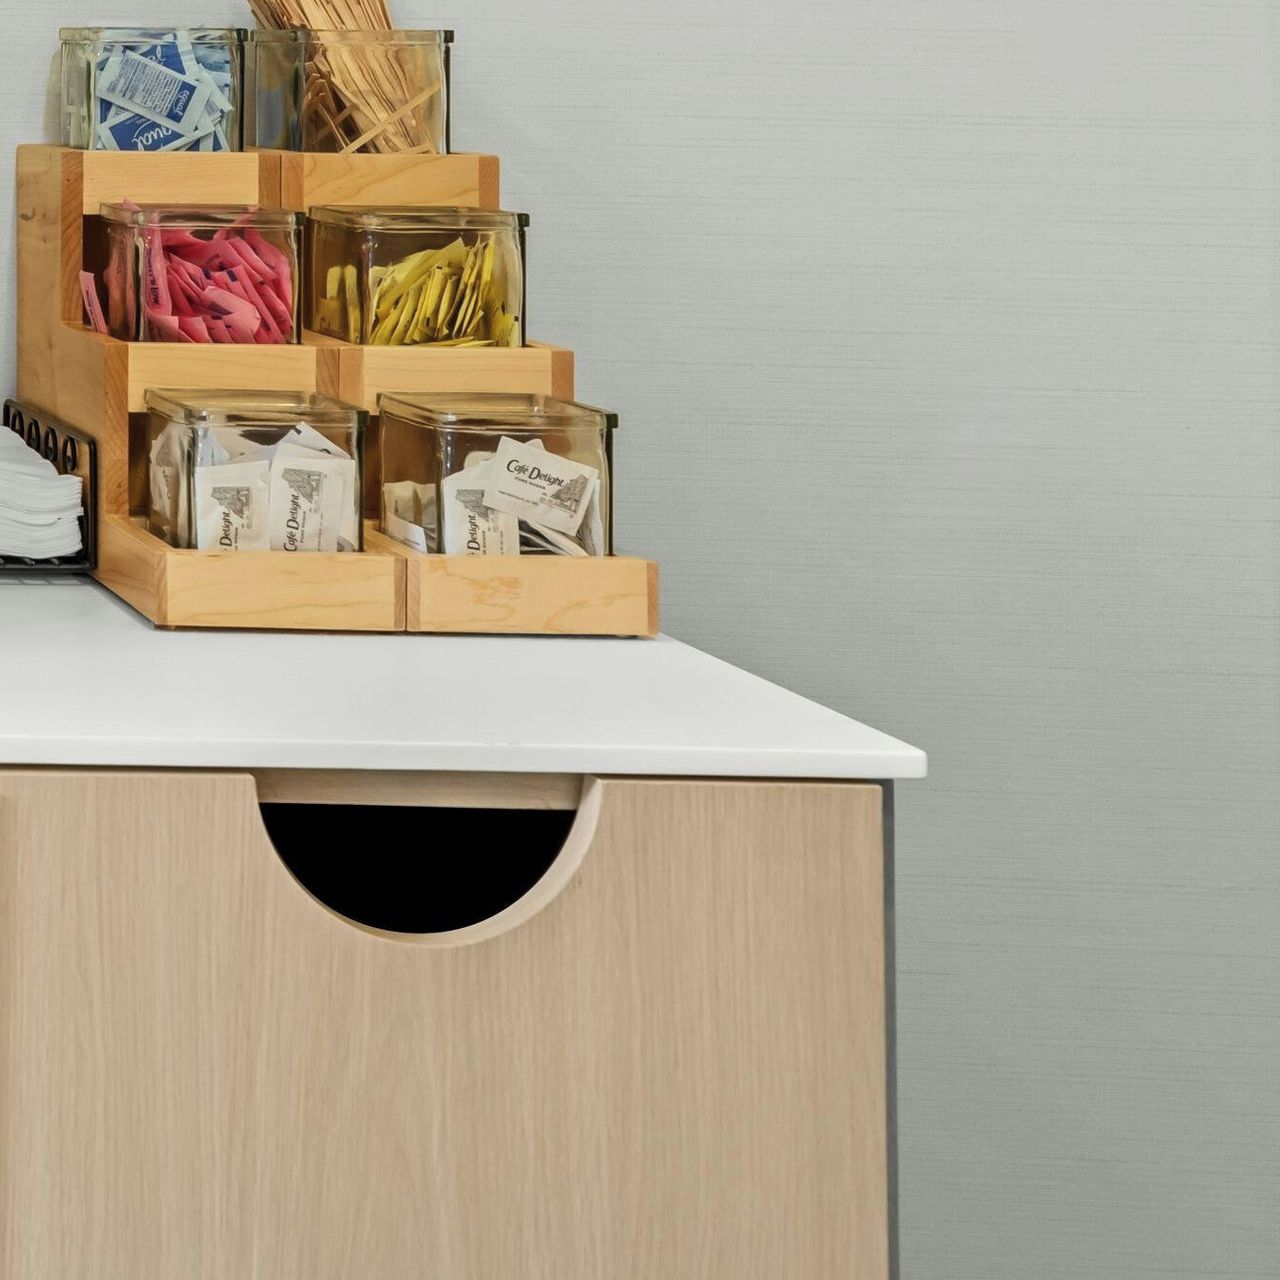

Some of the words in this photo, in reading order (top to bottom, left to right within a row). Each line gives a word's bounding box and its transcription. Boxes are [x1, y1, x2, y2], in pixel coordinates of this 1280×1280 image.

[506, 459, 530, 475] Café
[528, 467, 565, 487] Delight
[219, 512, 233, 547] Delight
[286, 494, 302, 530] Delight
[283, 531, 298, 552] Café
[466, 514, 480, 551] Delight
